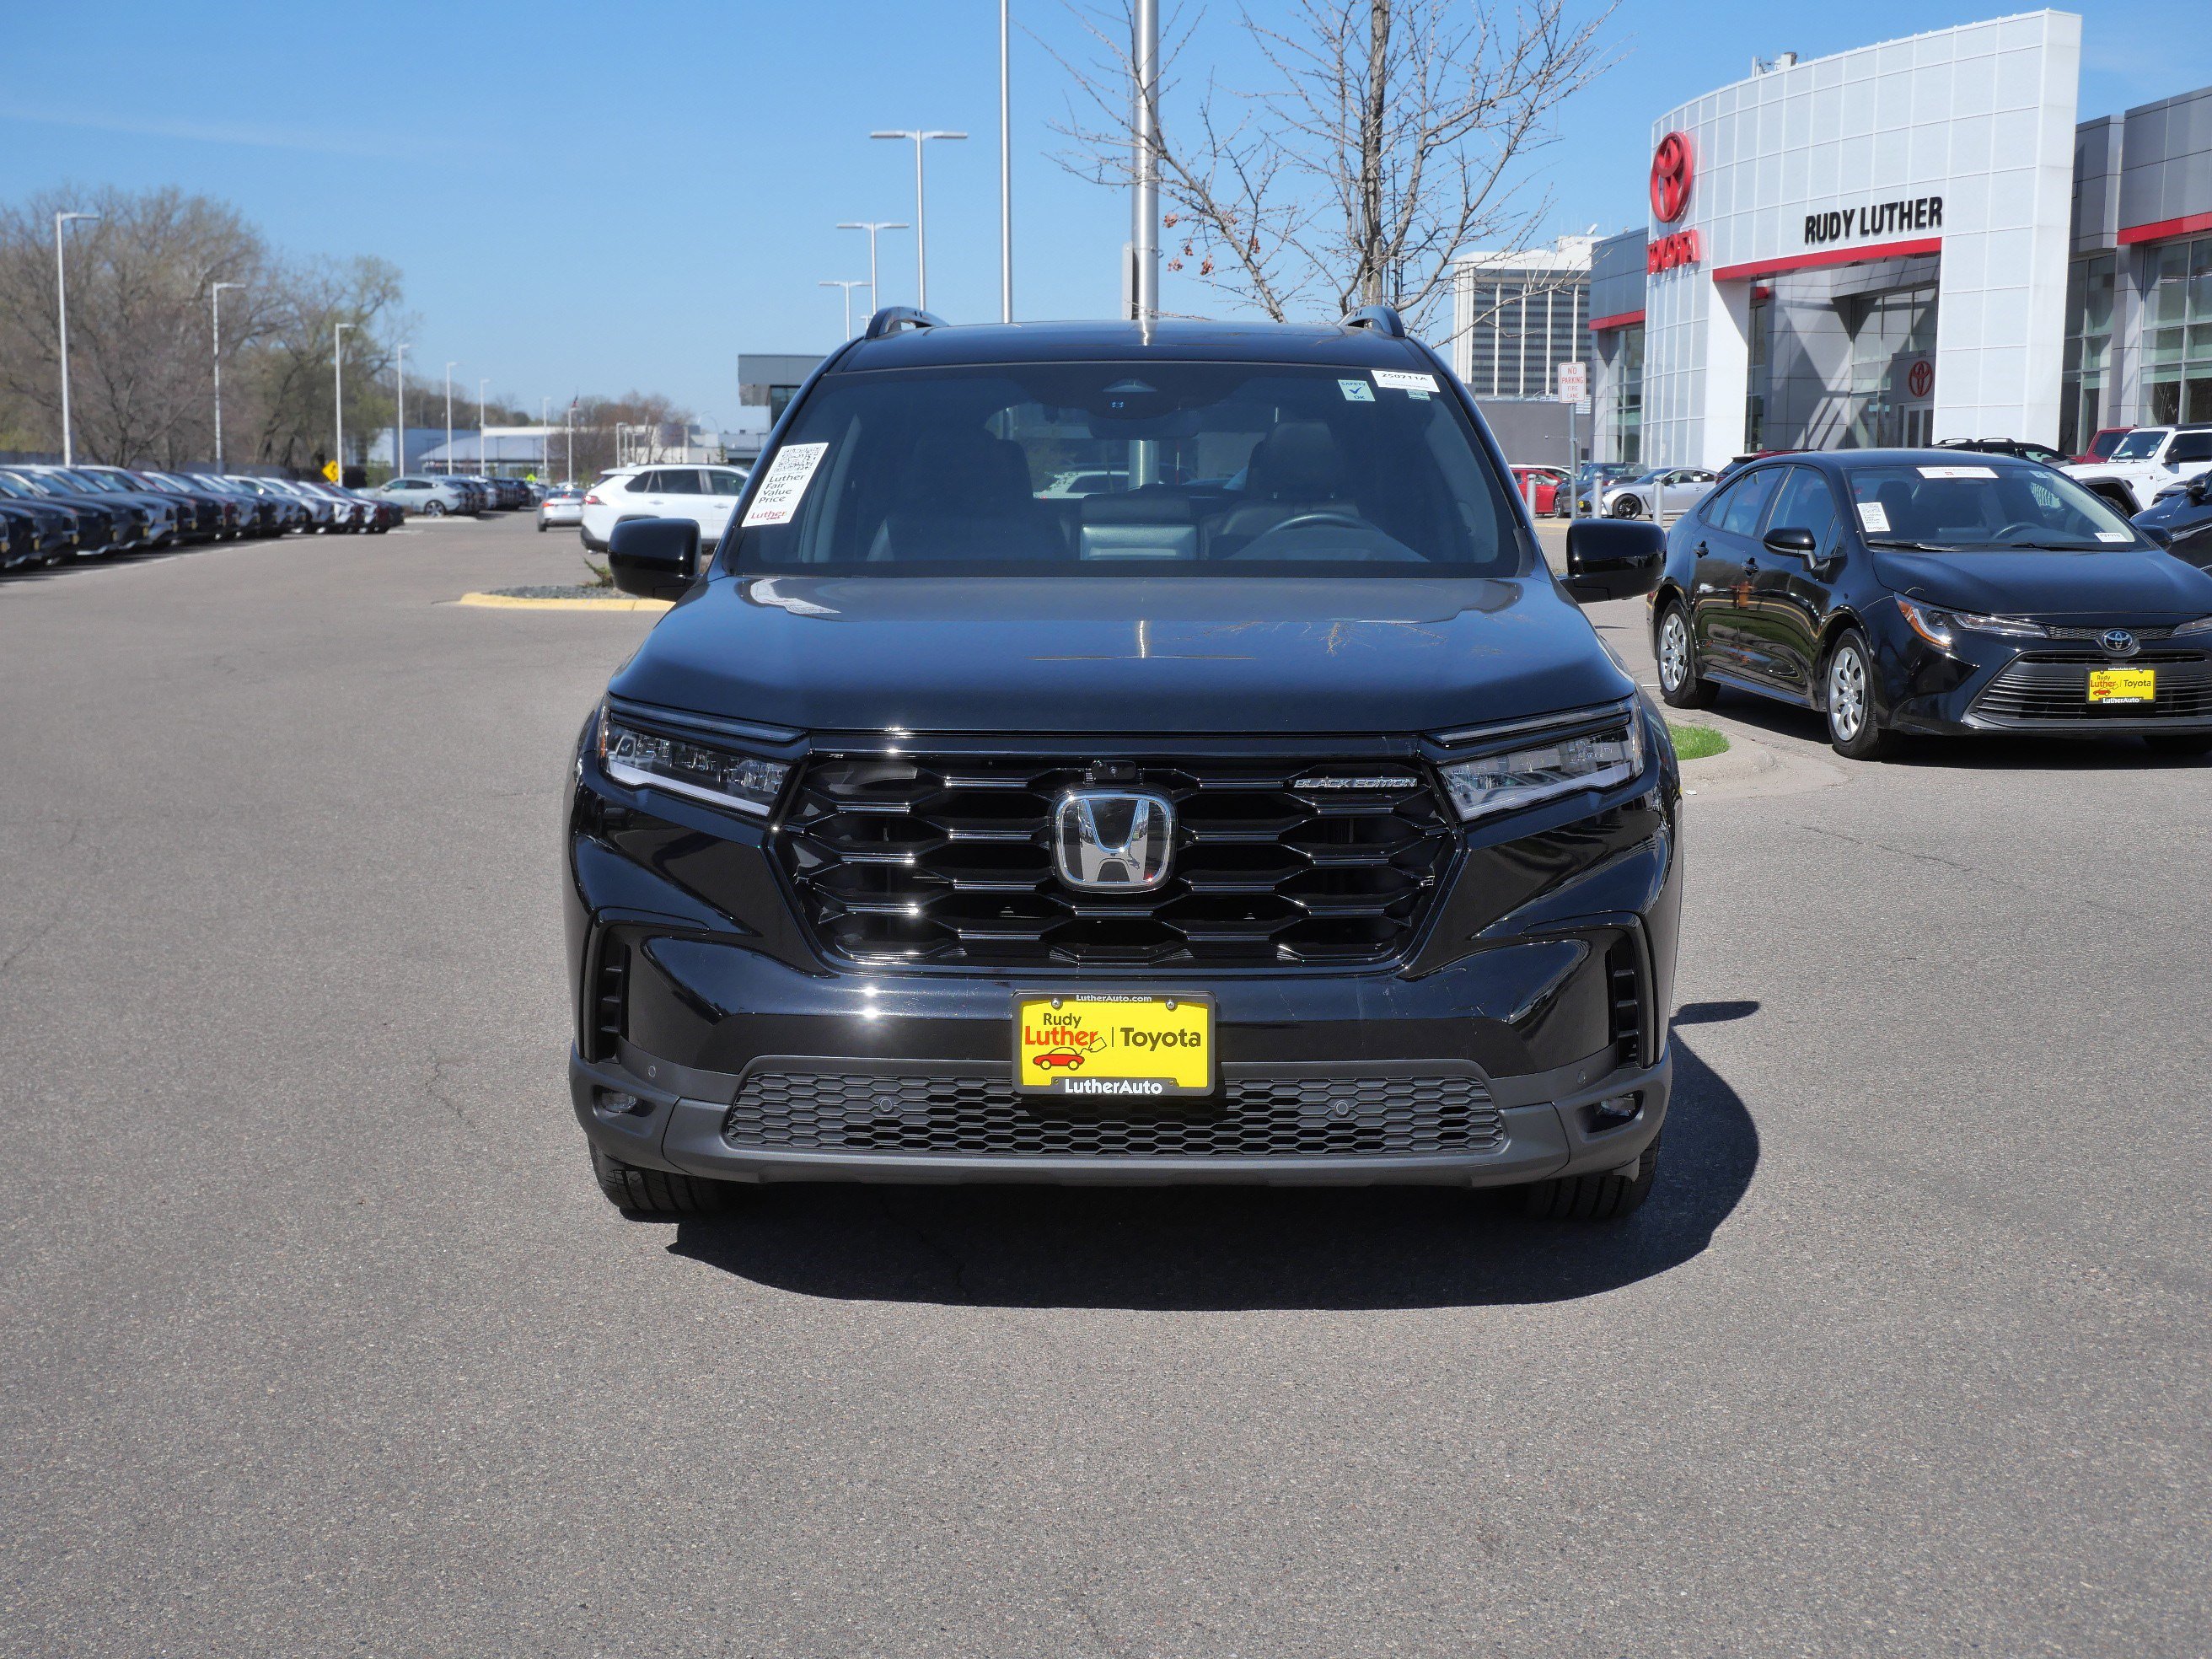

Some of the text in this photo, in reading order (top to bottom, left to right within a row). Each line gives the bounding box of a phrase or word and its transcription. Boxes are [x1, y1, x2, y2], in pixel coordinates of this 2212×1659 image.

[1805, 196, 1943, 244] RUDY LUTHER
[750, 511, 787, 519] Luther
[2123, 679, 2151, 688] Toyota
[1294, 778, 1417, 787] BLACK EDITION
[1043, 1013, 1082, 1028] Rudy
[1025, 1026, 1098, 1046] Luther
[1120, 1027, 1200, 1051] Toyota
[1065, 1078, 1162, 1095] LutherAuto
